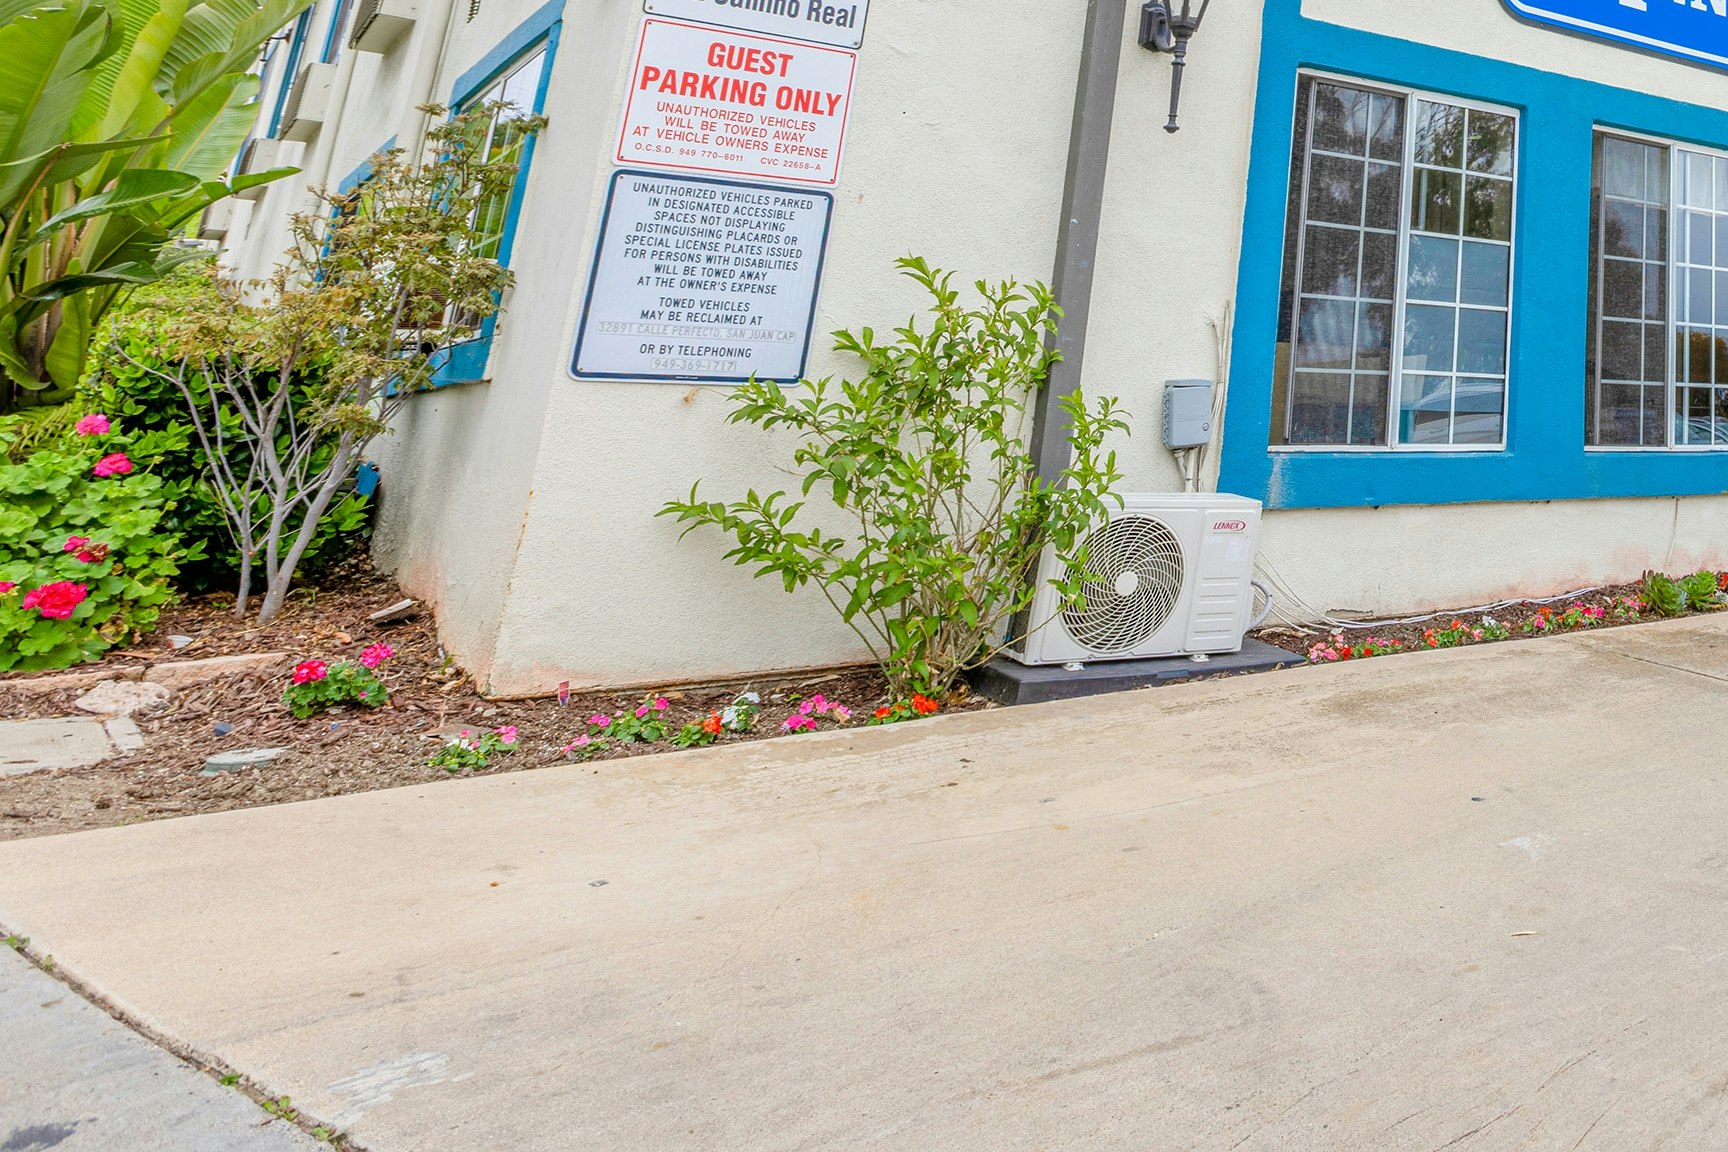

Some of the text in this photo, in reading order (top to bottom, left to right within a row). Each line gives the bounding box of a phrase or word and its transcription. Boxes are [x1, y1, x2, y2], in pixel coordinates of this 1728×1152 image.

[707, 42, 794, 77] GUEST
[640, 66, 842, 117] PARKING ONLY
[657, 102, 816, 131] UNAUTHORIZED VEHICLES
[665, 116, 806, 143] WILL BE TOWED AWAY
[633, 126, 828, 158] AT VEHICLE OWNERS EXPENSE
[635, 143, 744, 162] O.C.S.D. 949 770-6011
[761, 157, 821, 171] CVC 22658-A
[634, 183, 813, 210] UNAUTHORIZED VEHICLES PARKED
[648, 198, 795, 220] IN DESIGNATED ACCESSIBLE
[654, 211, 785, 232] SPACES NOT DISPLAYING
[635, 223, 797, 245] DISTINGUISHING PLACARDS OR
[625, 235, 802, 258] SPECIAL LICENSE PLATES ISSUED
[624, 248, 798, 271] FOR PERSONS WITH DISABILITIES
[654, 264, 768, 281] WILL BE TOWED AWAY
[637, 276, 777, 294] AT THE OWNER'S EXPENSE
[660, 297, 750, 311] TOWED VEHICLES
[641, 310, 763, 325] MAY BE RECLAIMED AT
[638, 324, 668, 334] CALLE
[671, 327, 722, 339] PERFECTO,
[727, 330, 745, 338] SAN
[750, 331, 773, 340] JUAN
[776, 333, 794, 341] CAP
[640, 344, 752, 357] OR BY TELEPHONING
[654, 360, 734, 371] 949-369-1717
[1213, 521, 1242, 530] LENNOX
